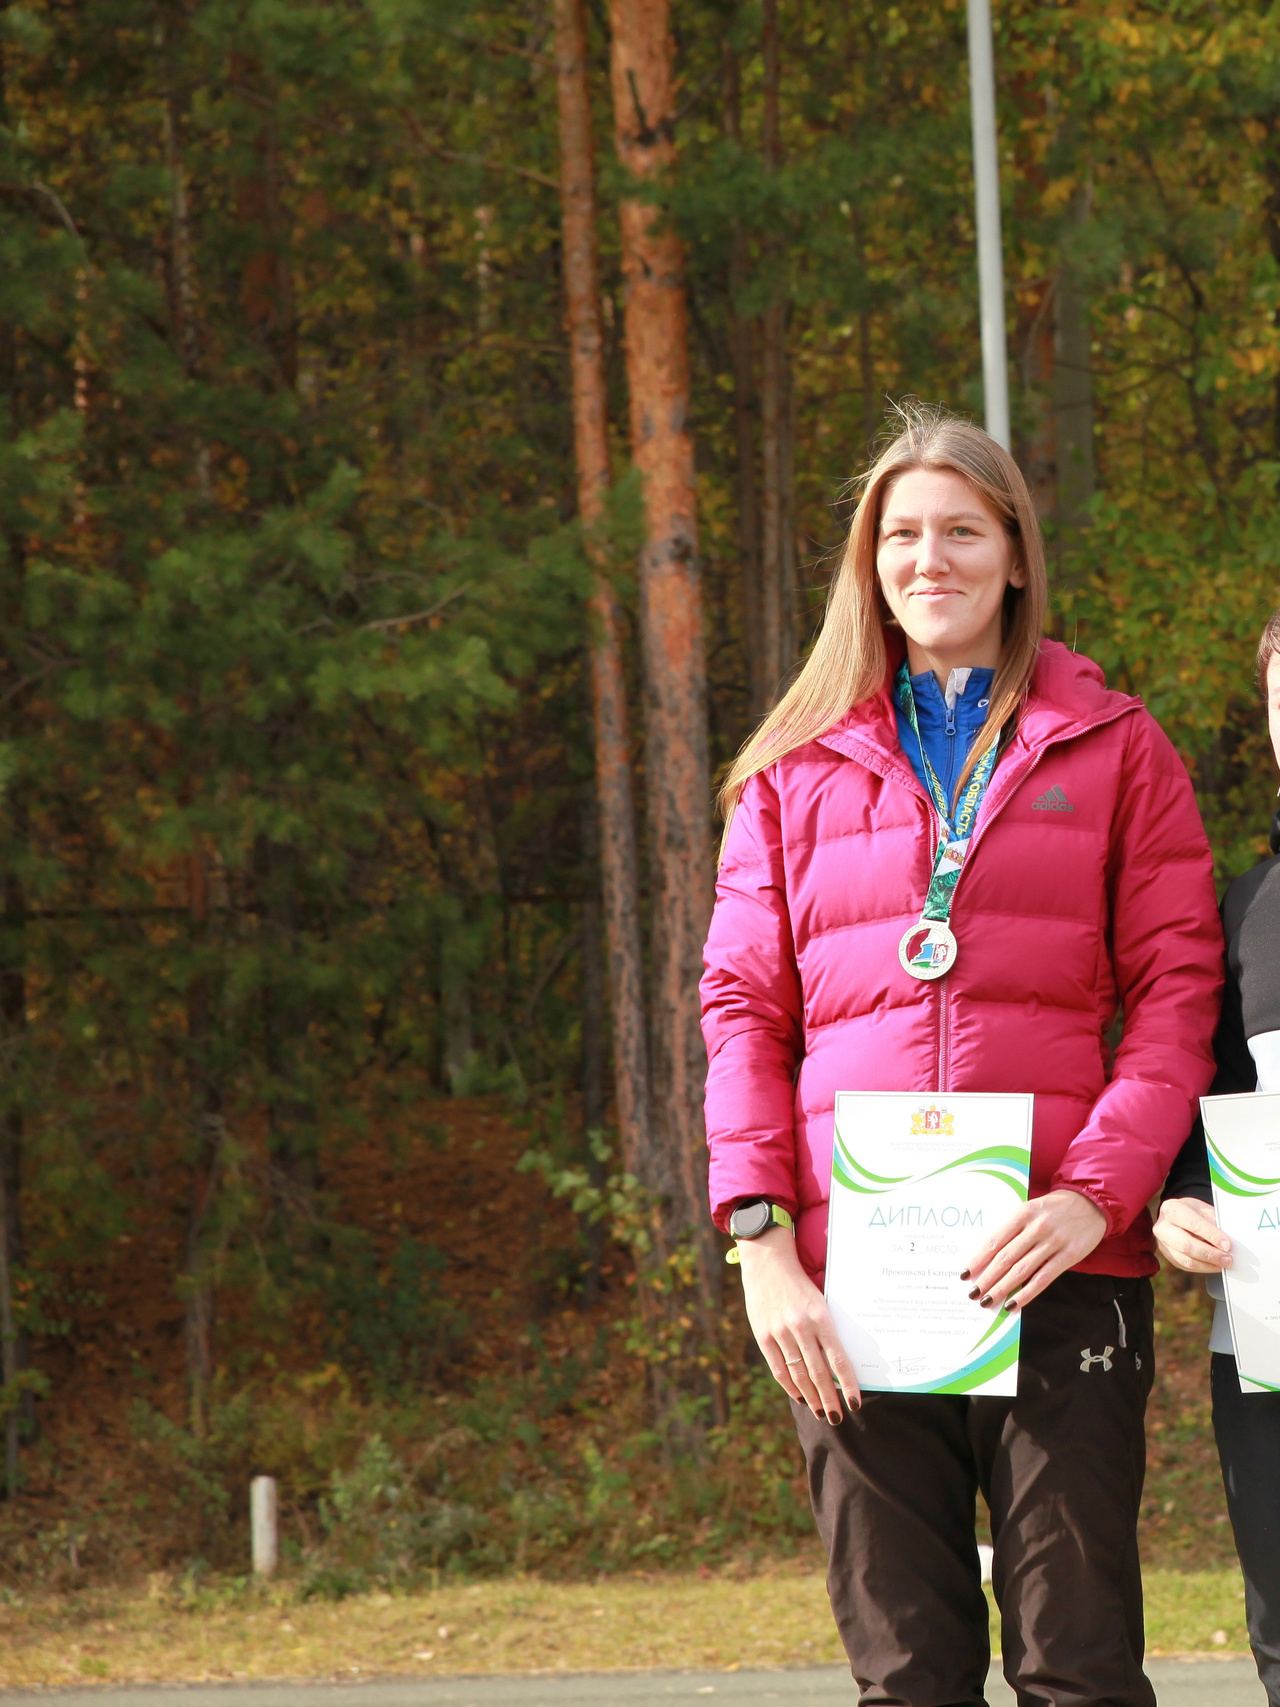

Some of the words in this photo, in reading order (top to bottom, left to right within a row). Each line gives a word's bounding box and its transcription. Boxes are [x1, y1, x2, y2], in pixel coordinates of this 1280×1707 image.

[956, 783, 980, 836] ОБЛАСТЬ
[1031, 800, 1075, 812] adidas
[868, 1205, 983, 1228] ДИПЛОМ
[909, 1241, 915, 1252] 2
[925, 1244, 958, 1254] МЕСТО
[927, 1268, 961, 1278] Екатерин
